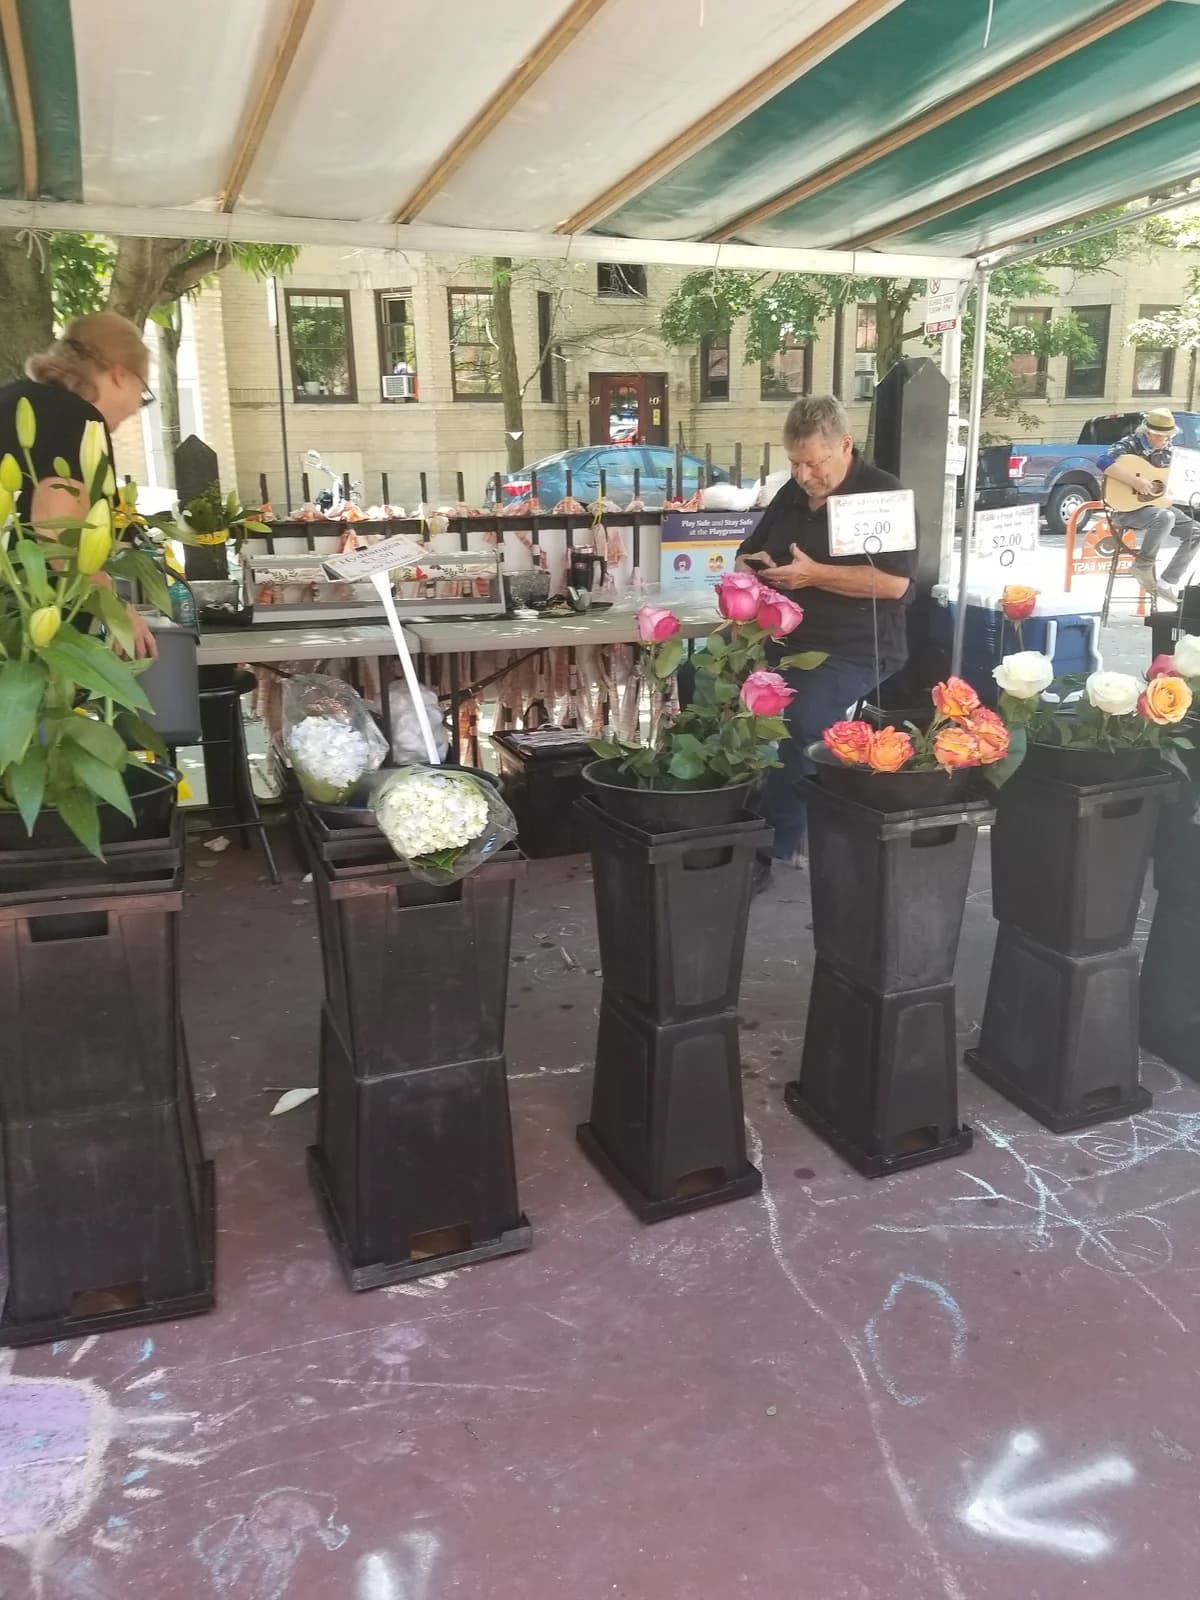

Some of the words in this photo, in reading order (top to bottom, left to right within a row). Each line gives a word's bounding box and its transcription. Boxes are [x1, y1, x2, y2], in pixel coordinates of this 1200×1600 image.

[681, 520, 695, 528] Play
[696, 519, 710, 527] Safe
[724, 519, 739, 527] Stay
[739, 518, 753, 526] Safe
[853, 520, 891, 537] $2.00
[697, 528, 708, 536] the
[709, 527, 745, 536] Playground
[991, 532, 1022, 549] $2.00
